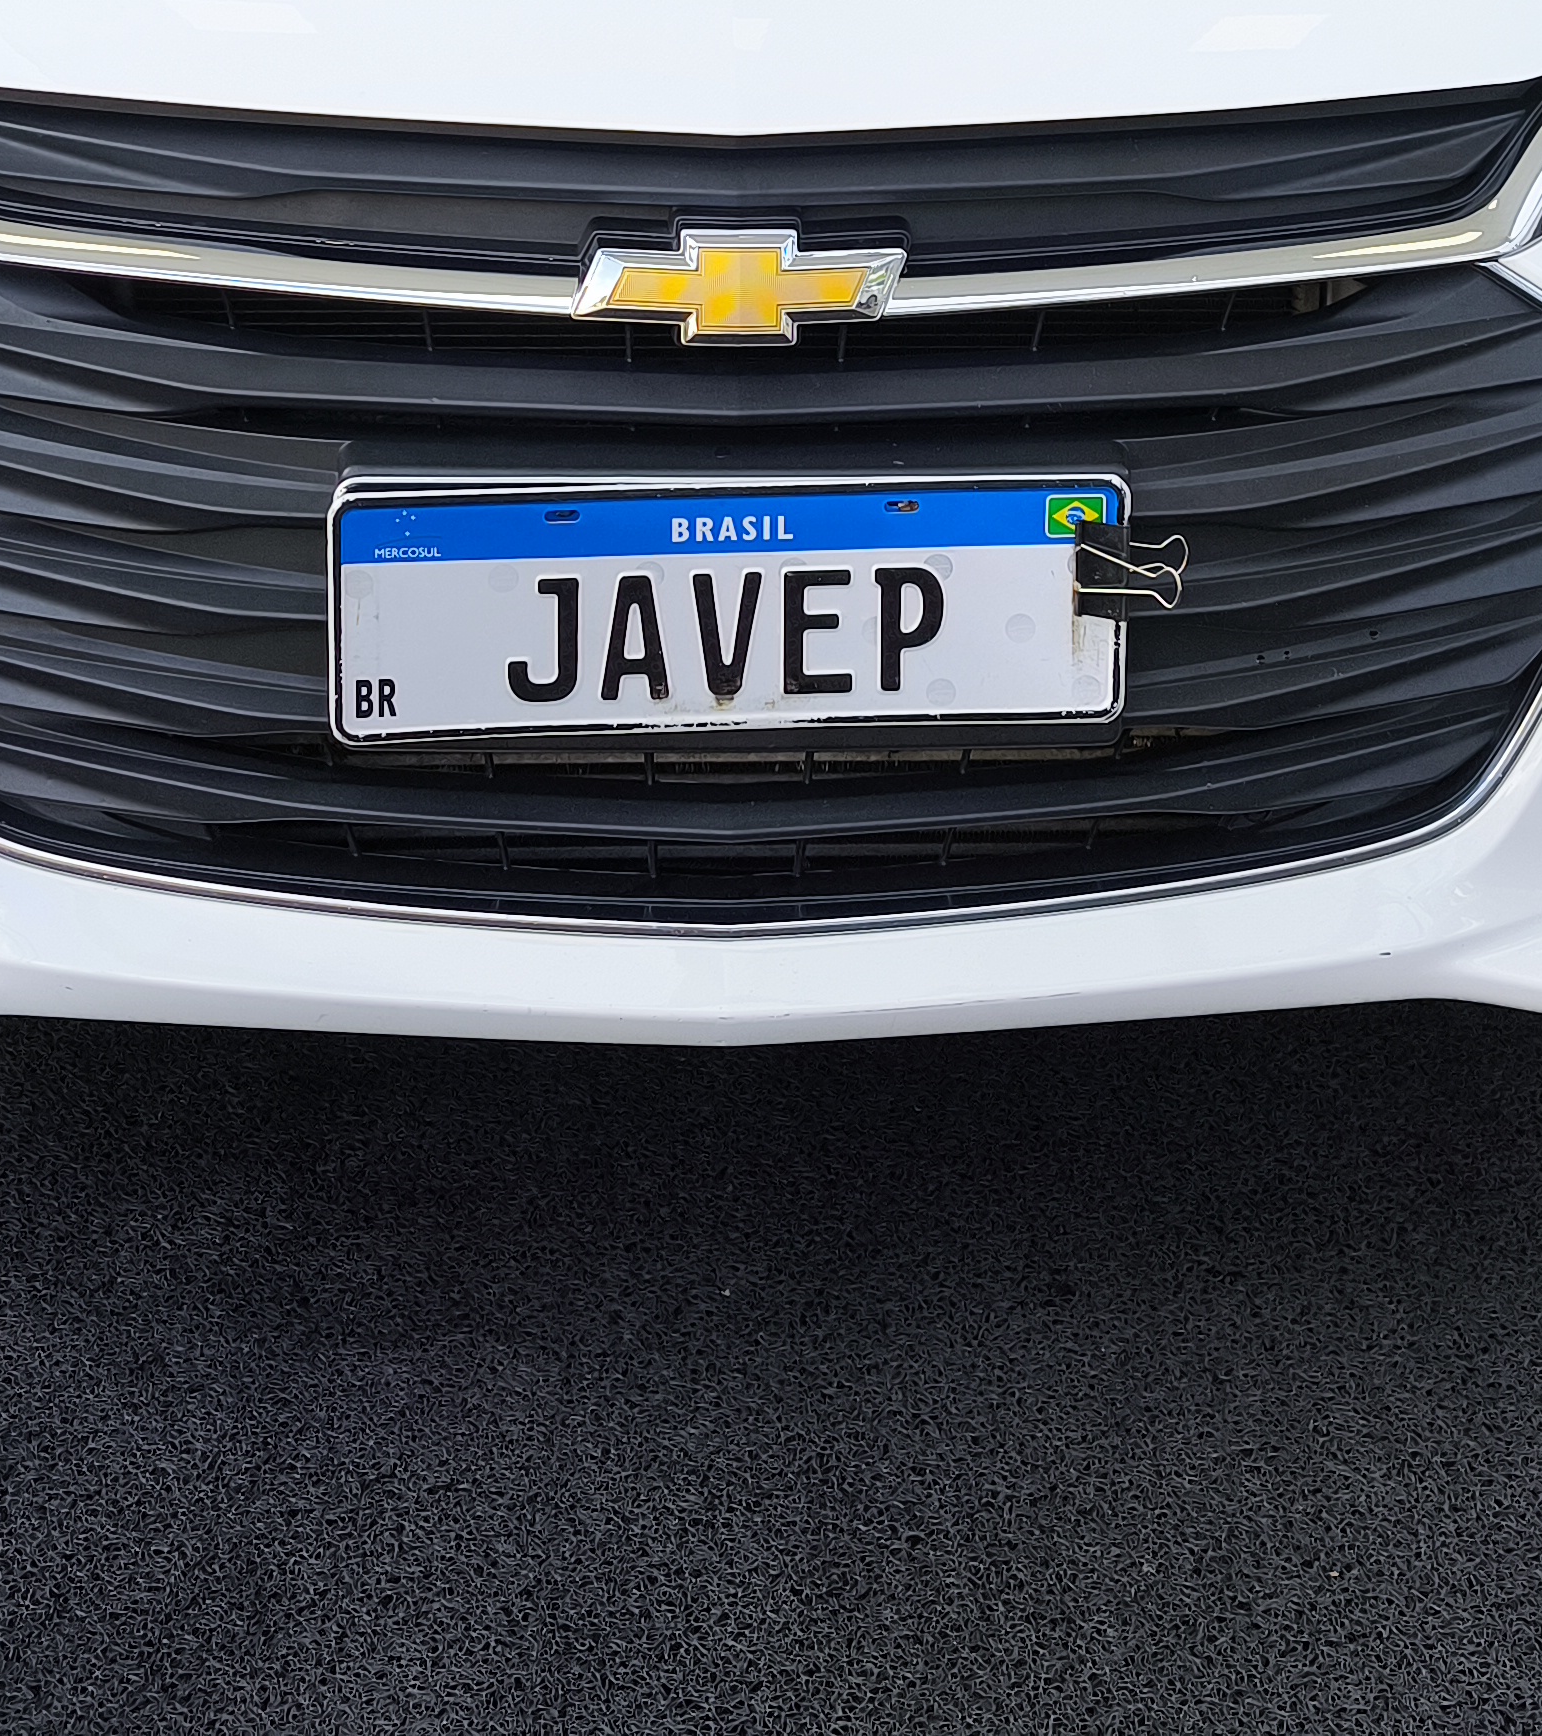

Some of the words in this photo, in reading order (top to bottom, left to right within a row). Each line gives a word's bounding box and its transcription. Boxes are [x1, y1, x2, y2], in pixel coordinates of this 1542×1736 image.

[670, 515, 794, 543] BRASIL
[374, 546, 442, 559] MERCOSUL
[507, 567, 944, 703] JAVEP
[355, 678, 397, 719] BR
